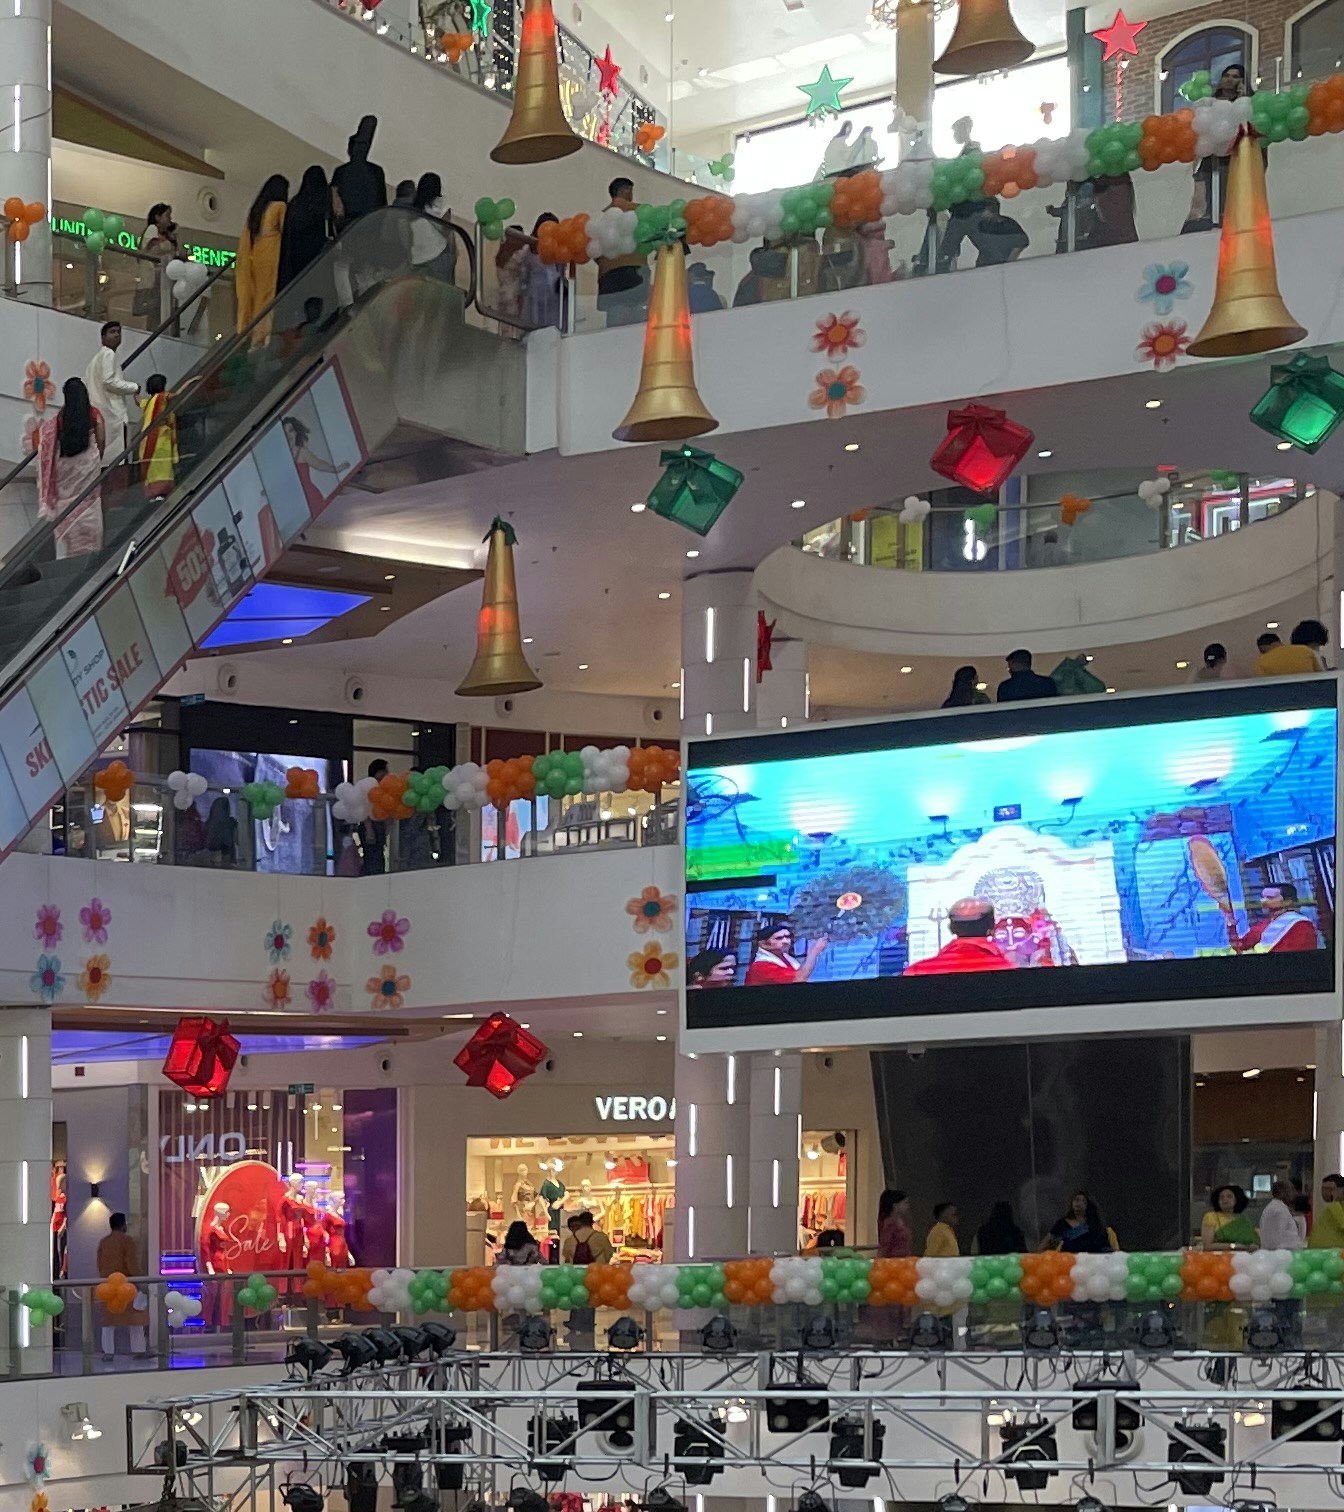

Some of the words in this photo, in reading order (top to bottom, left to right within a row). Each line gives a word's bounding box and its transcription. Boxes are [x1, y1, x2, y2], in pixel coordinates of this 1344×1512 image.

[107, 642, 144, 692] SALE
[595, 1096, 667, 1121] VERO
[225, 1215, 275, 1260] Sale
